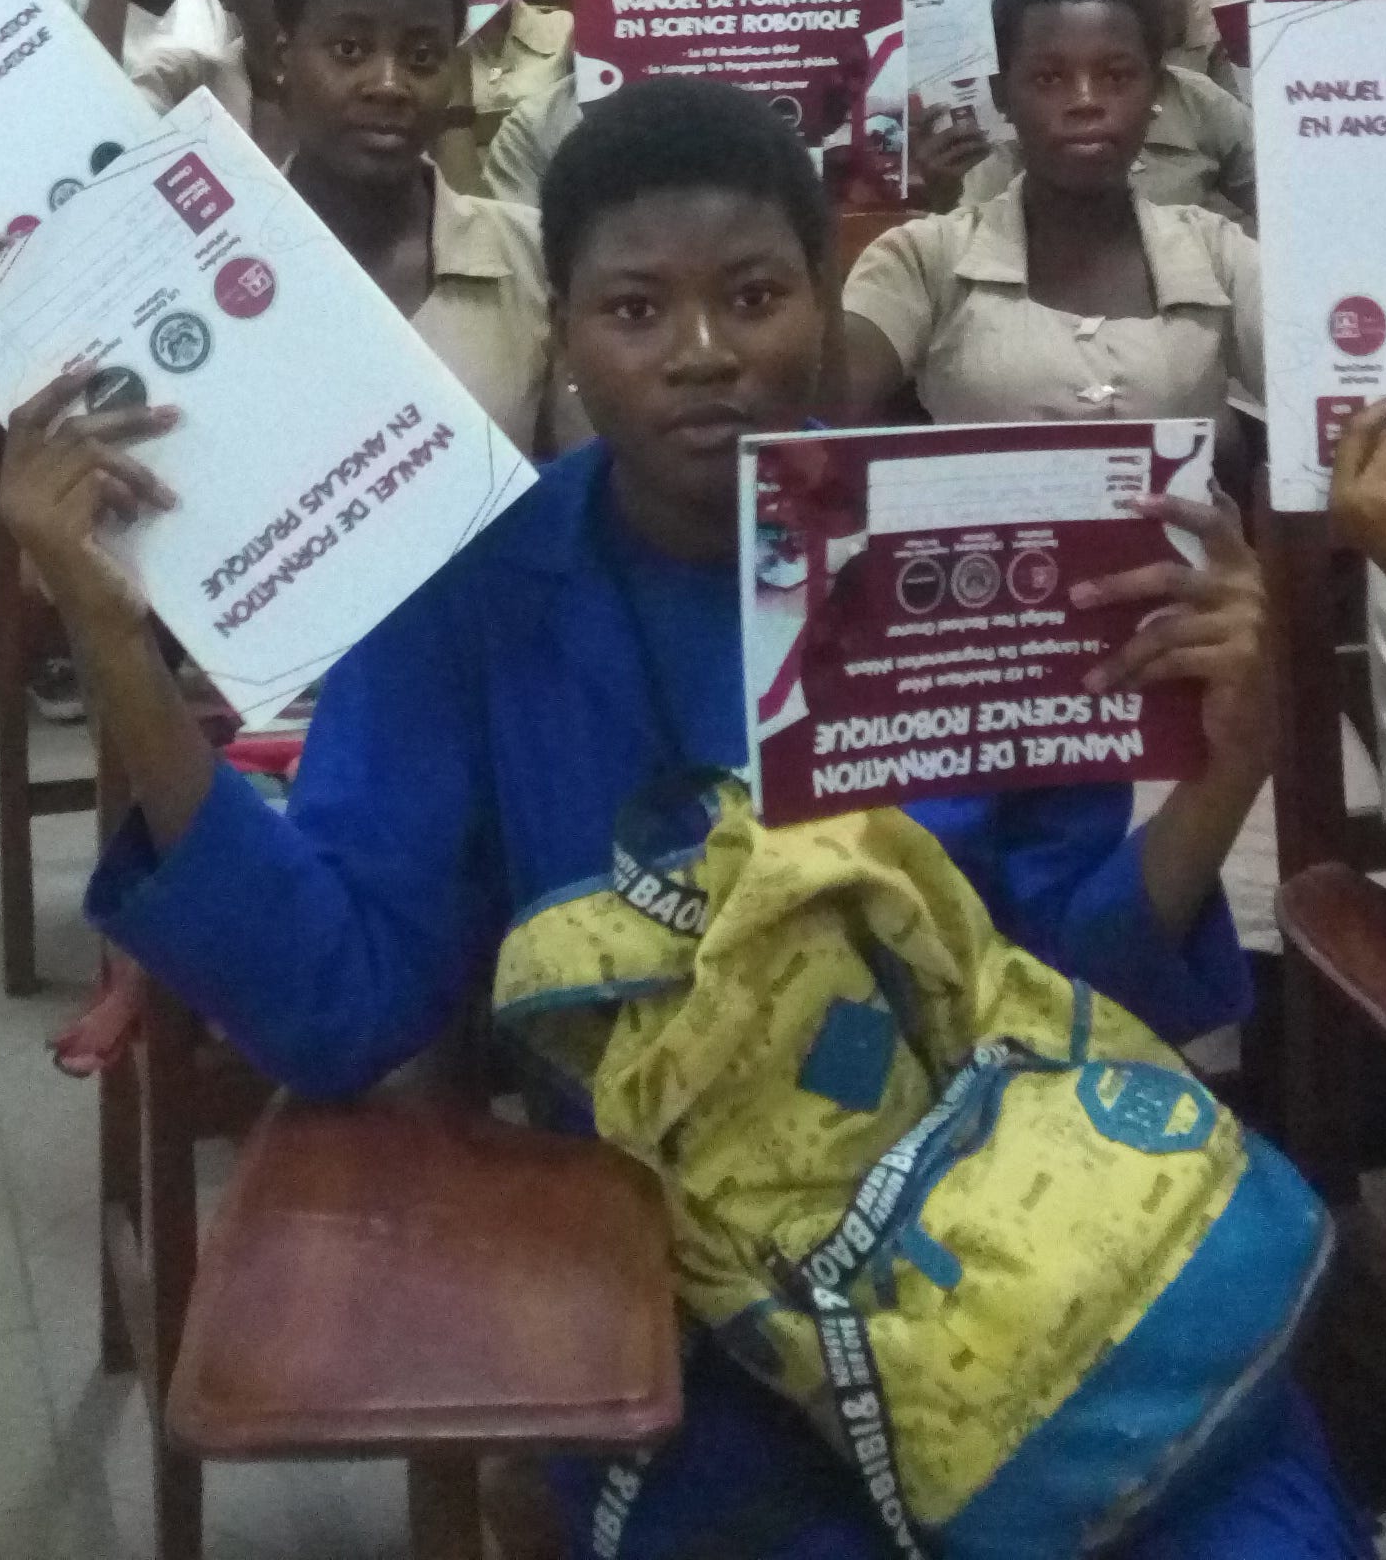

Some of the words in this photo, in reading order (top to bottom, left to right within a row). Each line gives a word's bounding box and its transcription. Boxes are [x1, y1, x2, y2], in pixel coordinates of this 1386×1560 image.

[613, 17, 645, 39] EN
[650, 14, 737, 37] SCIENCE
[741, 8, 859, 33] ROBOTIQUE
[1285, 80, 1384, 104] MANUEL
[1299, 115, 1331, 137] EN
[385, 403, 422, 438] EN
[298, 431, 386, 514] ANGLAIS
[365, 423, 454, 502] MANUEL
[335, 497, 371, 533] DE
[201, 509, 301, 599] PRATIQUE
[214, 525, 338, 636] FORMATION
[977, 695, 1091, 731] SCIENCE
[1099, 693, 1142, 722] EN
[814, 707, 970, 754] ROBOTIQUE
[1022, 729, 1143, 766] MANUEL
[812, 747, 971, 796] FORMATION
[977, 739, 1015, 772] DE
